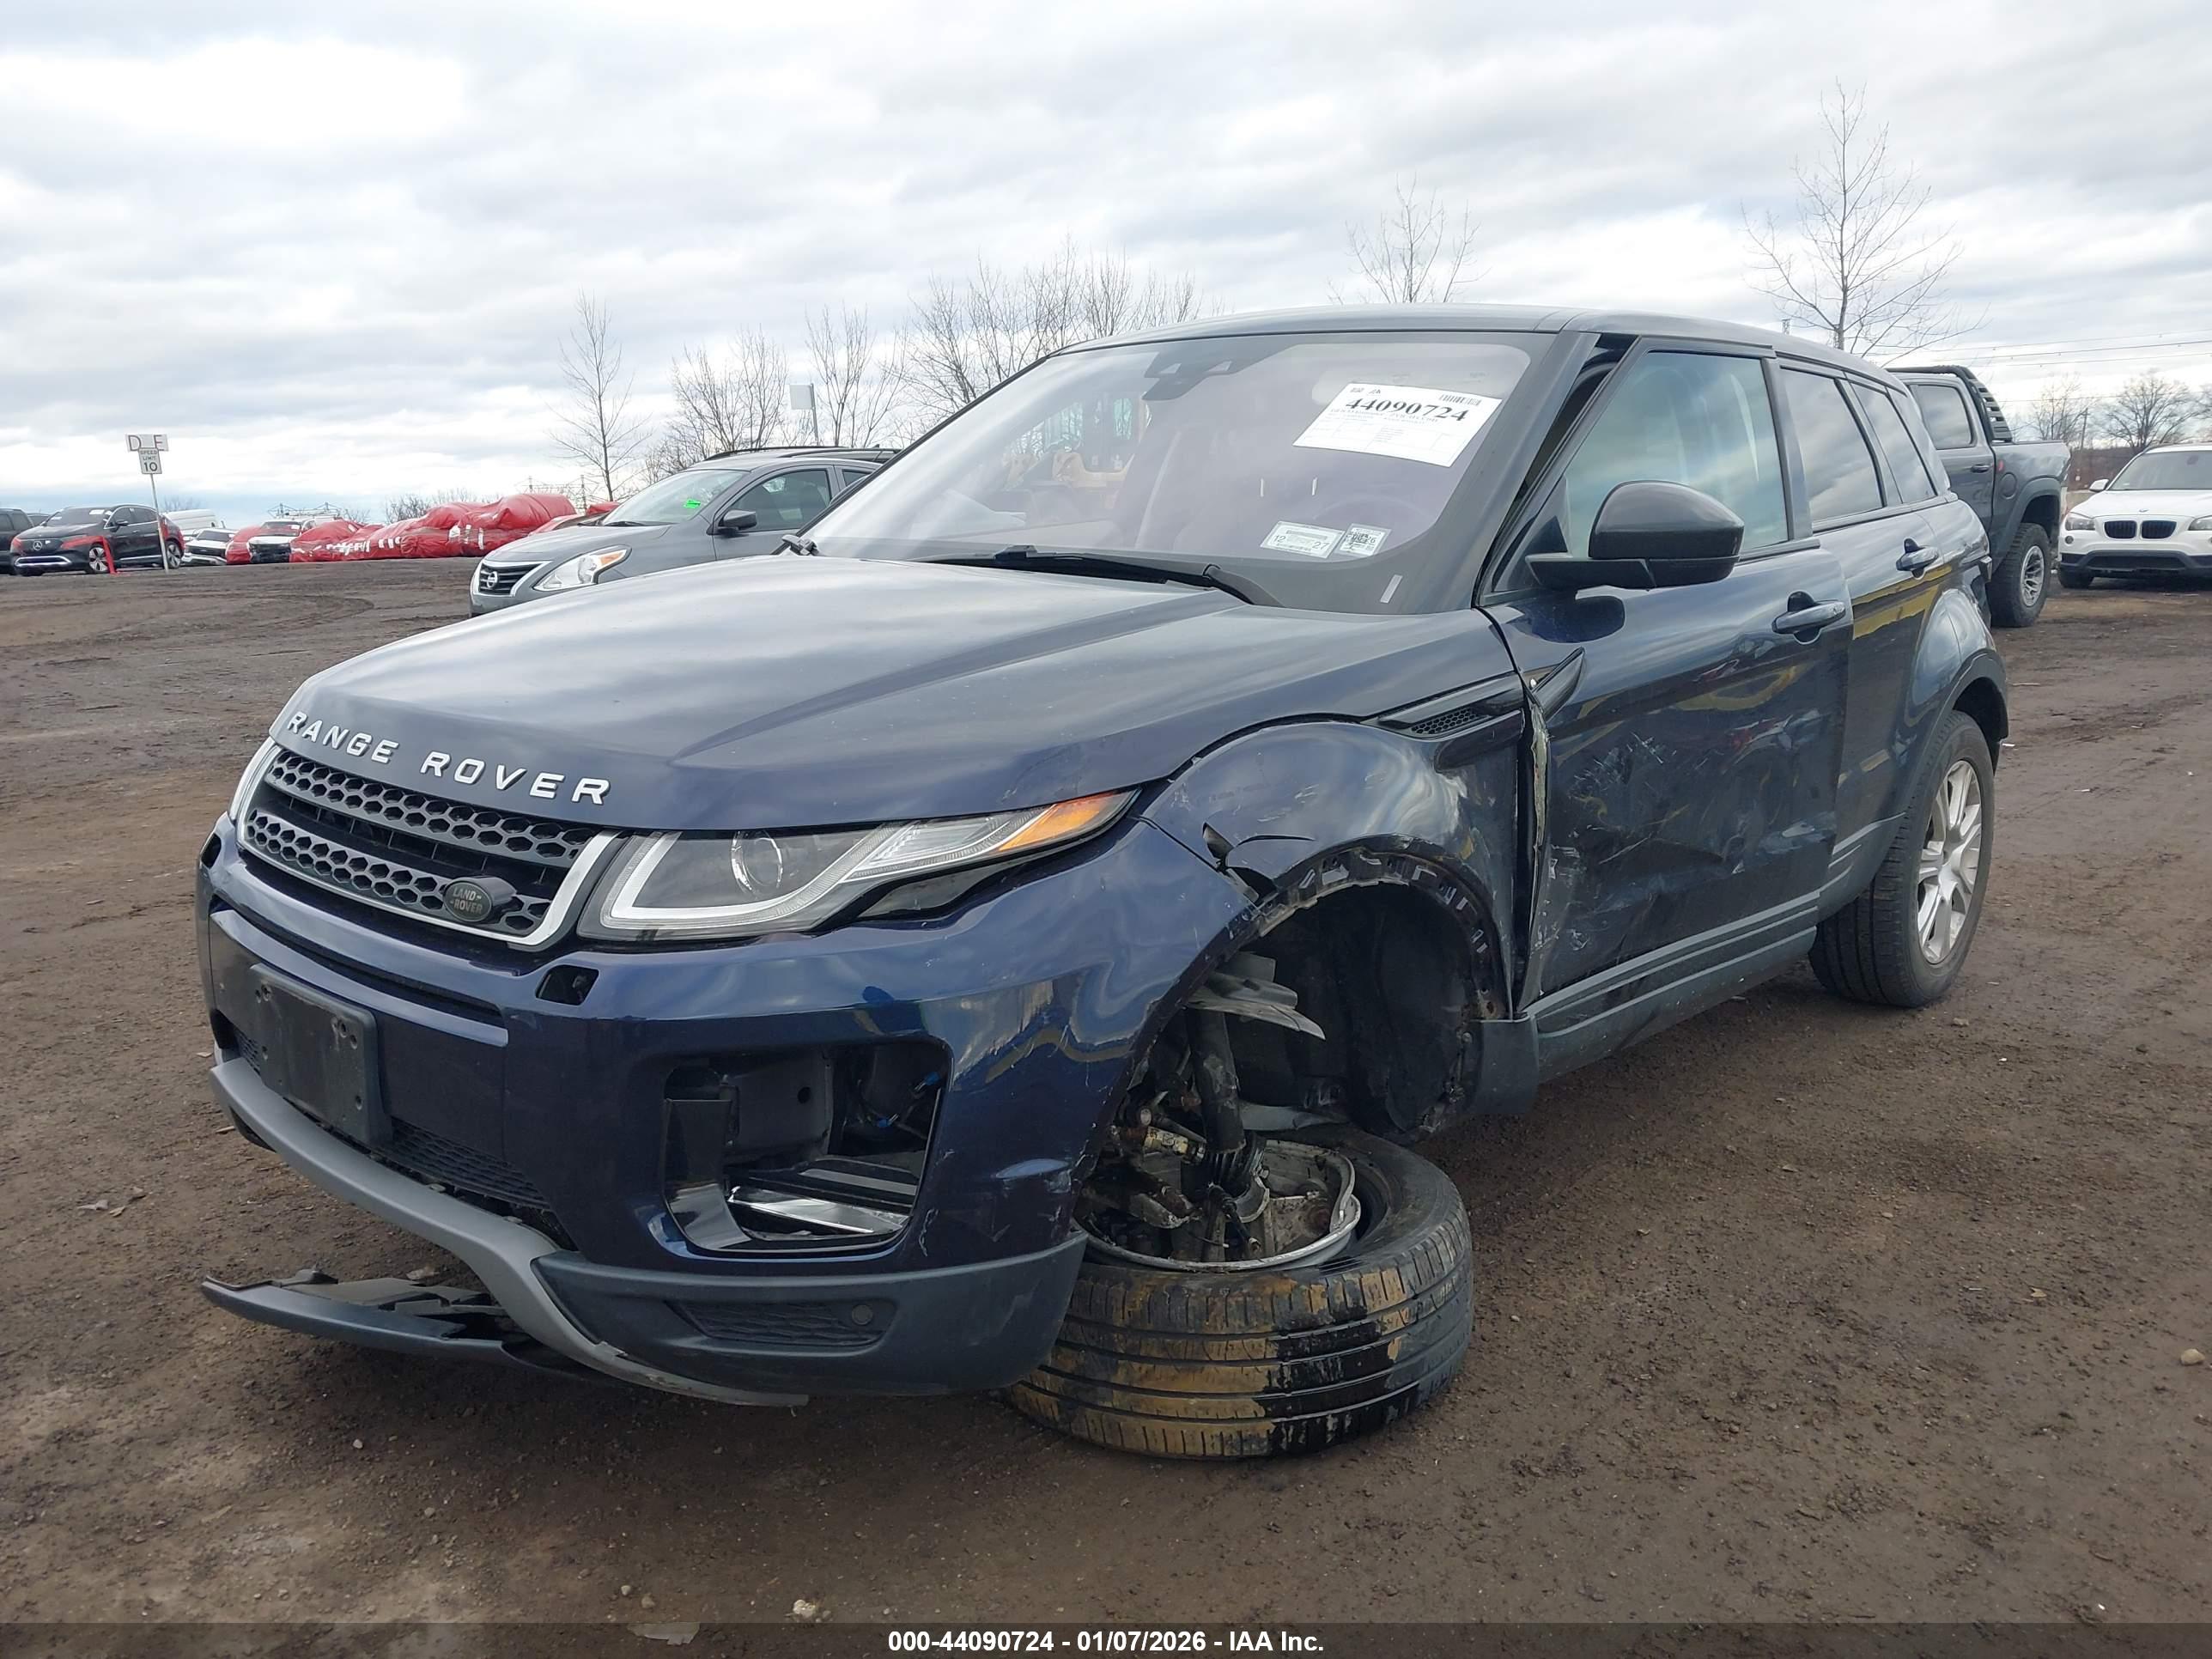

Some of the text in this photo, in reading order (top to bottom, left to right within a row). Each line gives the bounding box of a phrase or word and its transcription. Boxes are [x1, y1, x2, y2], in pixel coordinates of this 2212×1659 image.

[1346, 398, 1469, 422] 44090724
[128, 434, 165, 452] D E
[143, 462, 158, 472] 10
[1312, 541, 1329, 550] 27
[287, 711, 611, 805] RANGE ROVER
